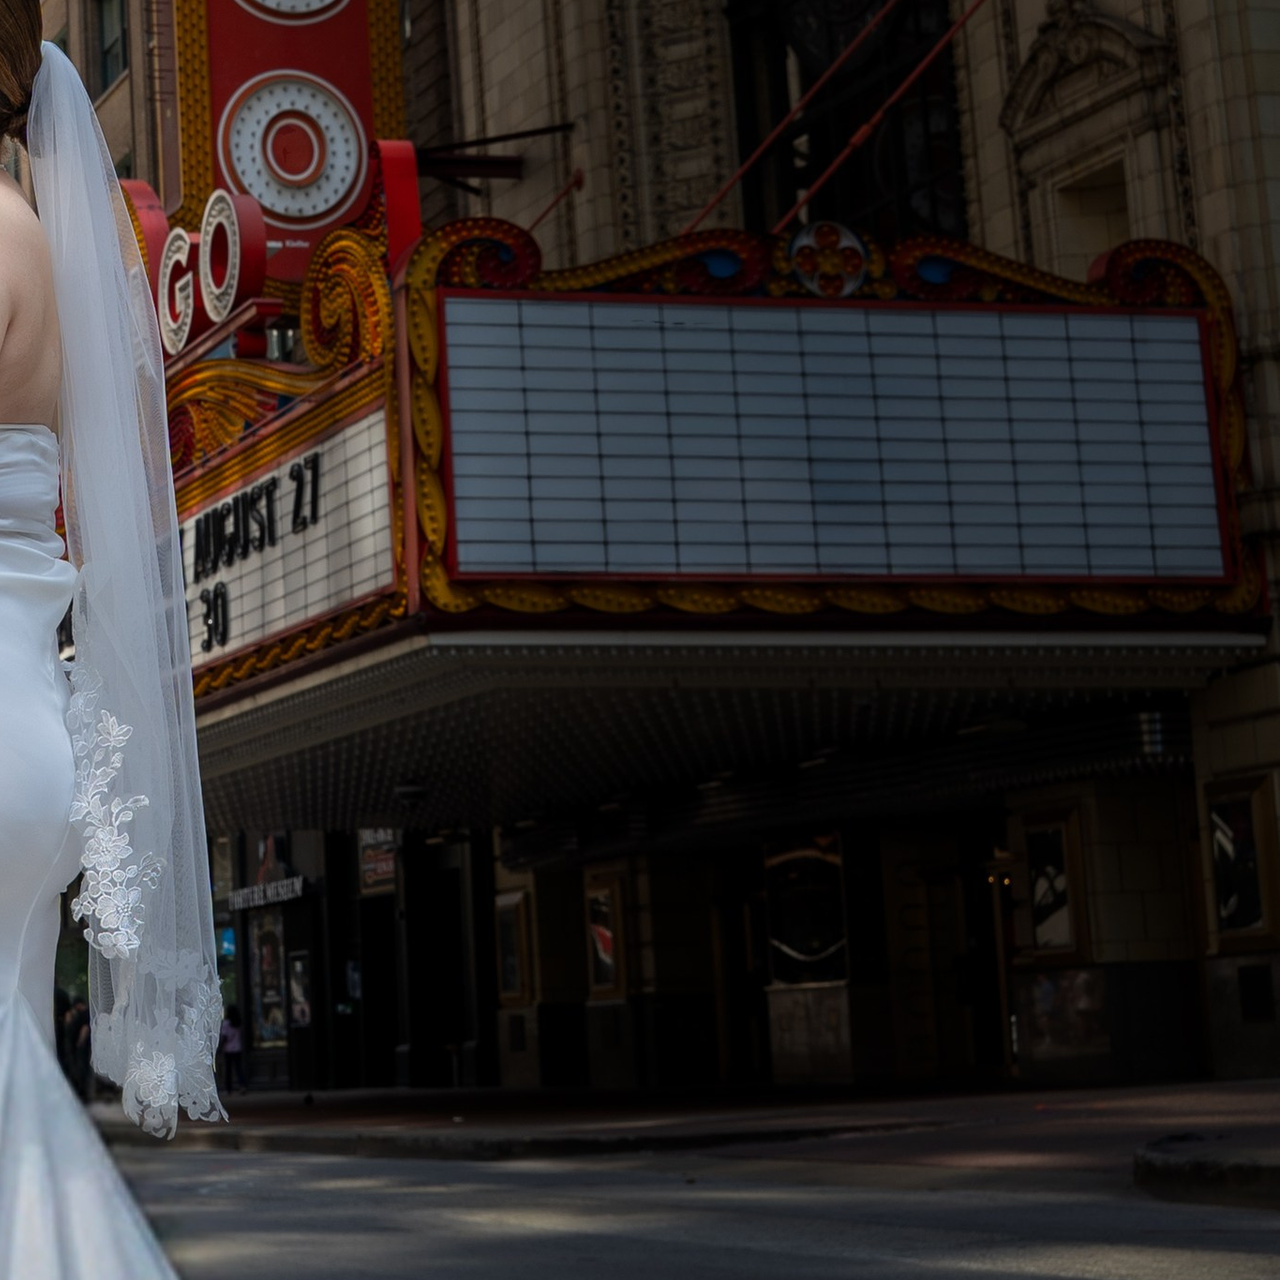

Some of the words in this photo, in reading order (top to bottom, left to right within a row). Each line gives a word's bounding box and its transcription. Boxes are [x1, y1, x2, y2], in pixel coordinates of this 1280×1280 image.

[193, 476, 278, 584] AUGUST
[289, 452, 320, 534] 27
[200, 581, 229, 653] 30
